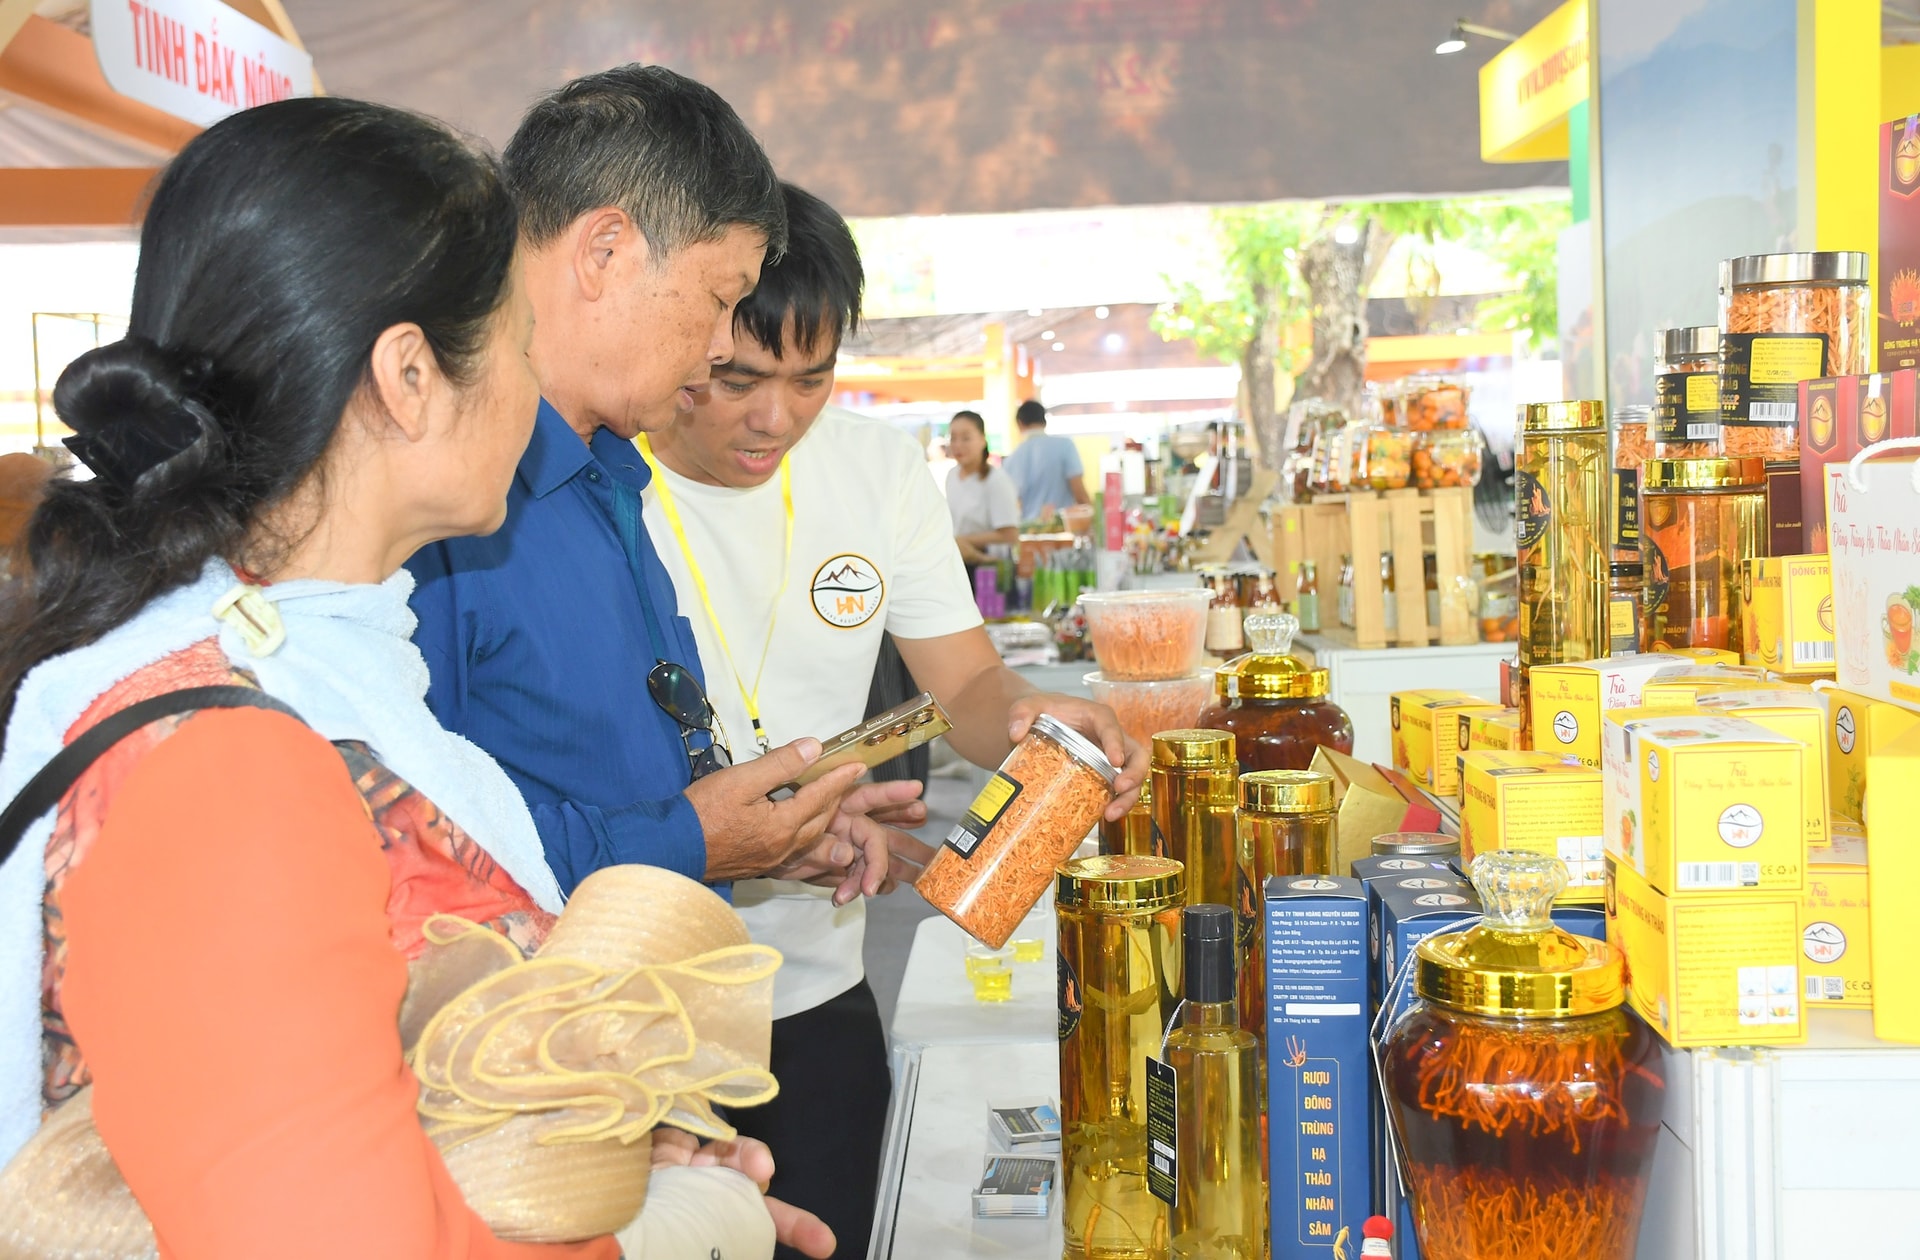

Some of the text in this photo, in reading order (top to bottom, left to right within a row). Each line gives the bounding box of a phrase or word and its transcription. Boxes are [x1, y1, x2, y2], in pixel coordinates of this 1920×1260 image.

[1791, 565, 1816, 576] ĐÔNG
[1607, 674, 1626, 694] Trà
[1303, 1071, 1330, 1087] RƯỢU
[1304, 1095, 1332, 1110] ĐÔNG
[1301, 1121, 1334, 1135] TRÙNG
[1312, 1147, 1327, 1162] HẠ
[1304, 1169, 1332, 1186] THẢO
[1305, 1195, 1334, 1211] NHÂN
[1308, 1220, 1332, 1236] SÂM
